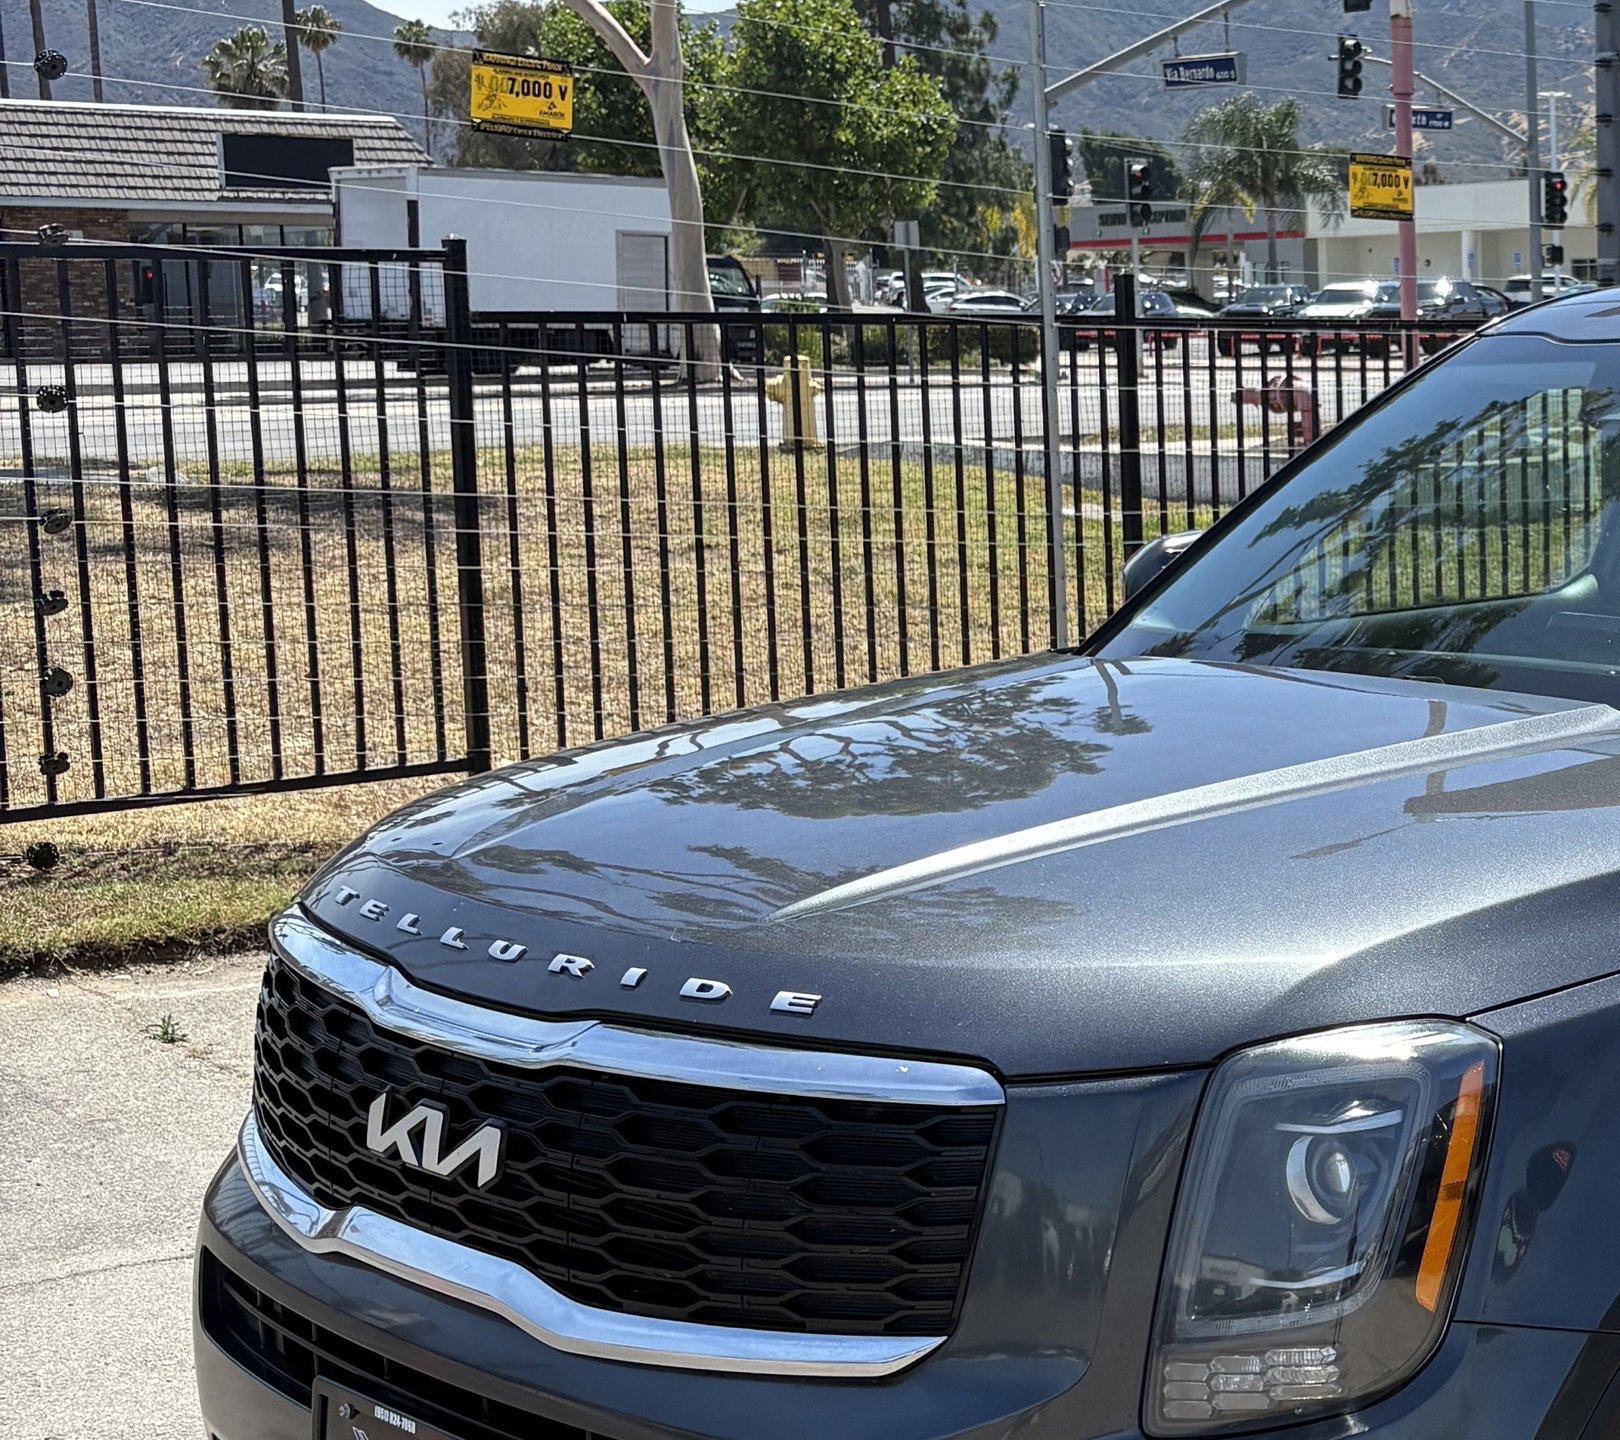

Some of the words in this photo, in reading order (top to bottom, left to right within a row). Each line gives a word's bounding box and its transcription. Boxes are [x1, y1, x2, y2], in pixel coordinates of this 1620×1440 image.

[507, 76, 553, 99] 7,000
[558, 85, 568, 101] V
[334, 884, 824, 1015] TELLURIDE
